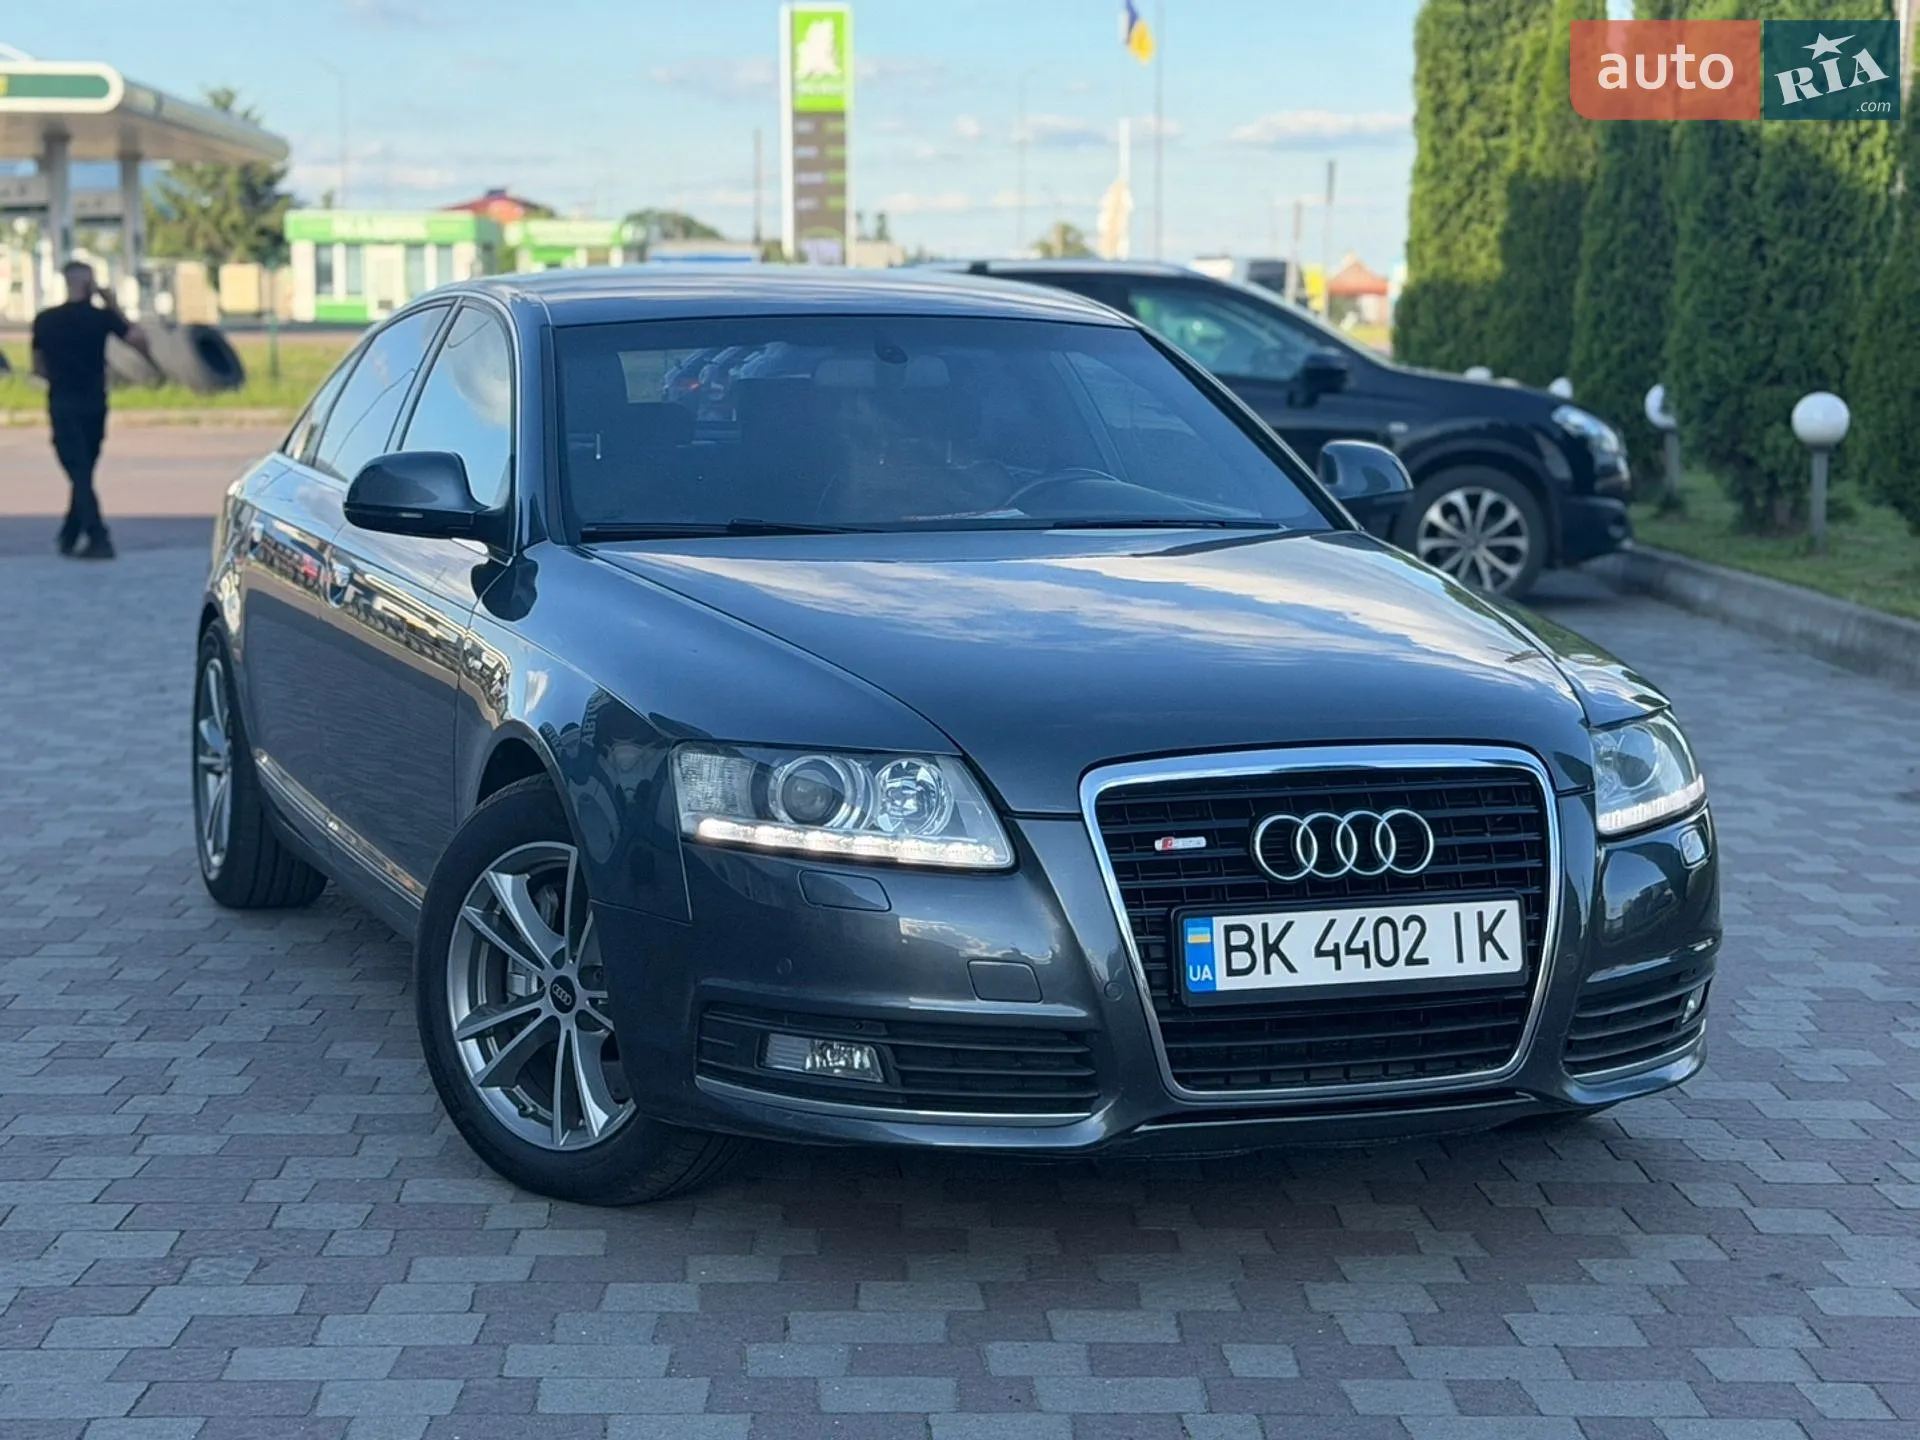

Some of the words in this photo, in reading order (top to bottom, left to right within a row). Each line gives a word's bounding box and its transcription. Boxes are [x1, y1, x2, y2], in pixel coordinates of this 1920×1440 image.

[1223, 920, 1298, 977] BK
[1314, 914, 1429, 971] 4402
[1453, 908, 1510, 963] IK
[1189, 964, 1214, 983] UA
